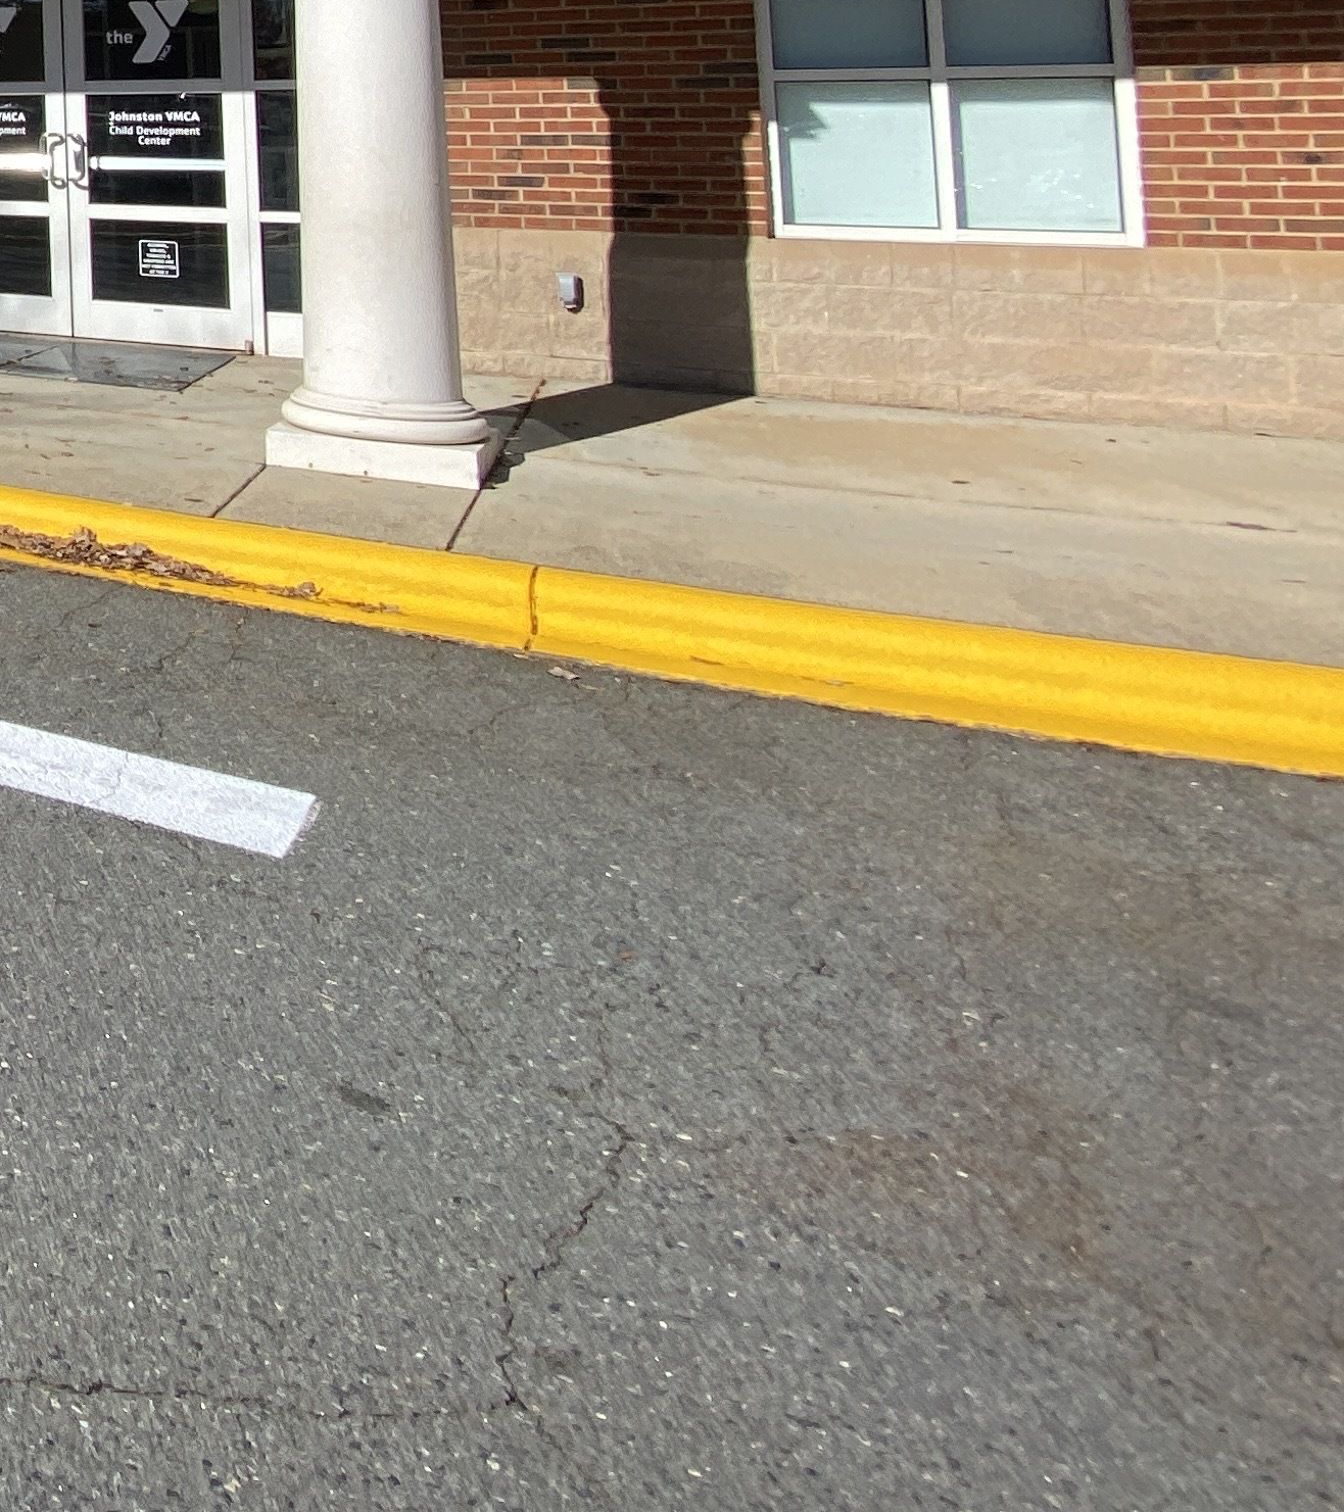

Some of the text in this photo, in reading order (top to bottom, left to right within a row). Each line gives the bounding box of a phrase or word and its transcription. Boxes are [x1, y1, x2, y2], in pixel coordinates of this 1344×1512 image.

[105, 29, 133, 45] the
[109, 111, 200, 122] Johnston YMCA
[109, 126, 200, 137] Child Development
[138, 136, 171, 145] Center
